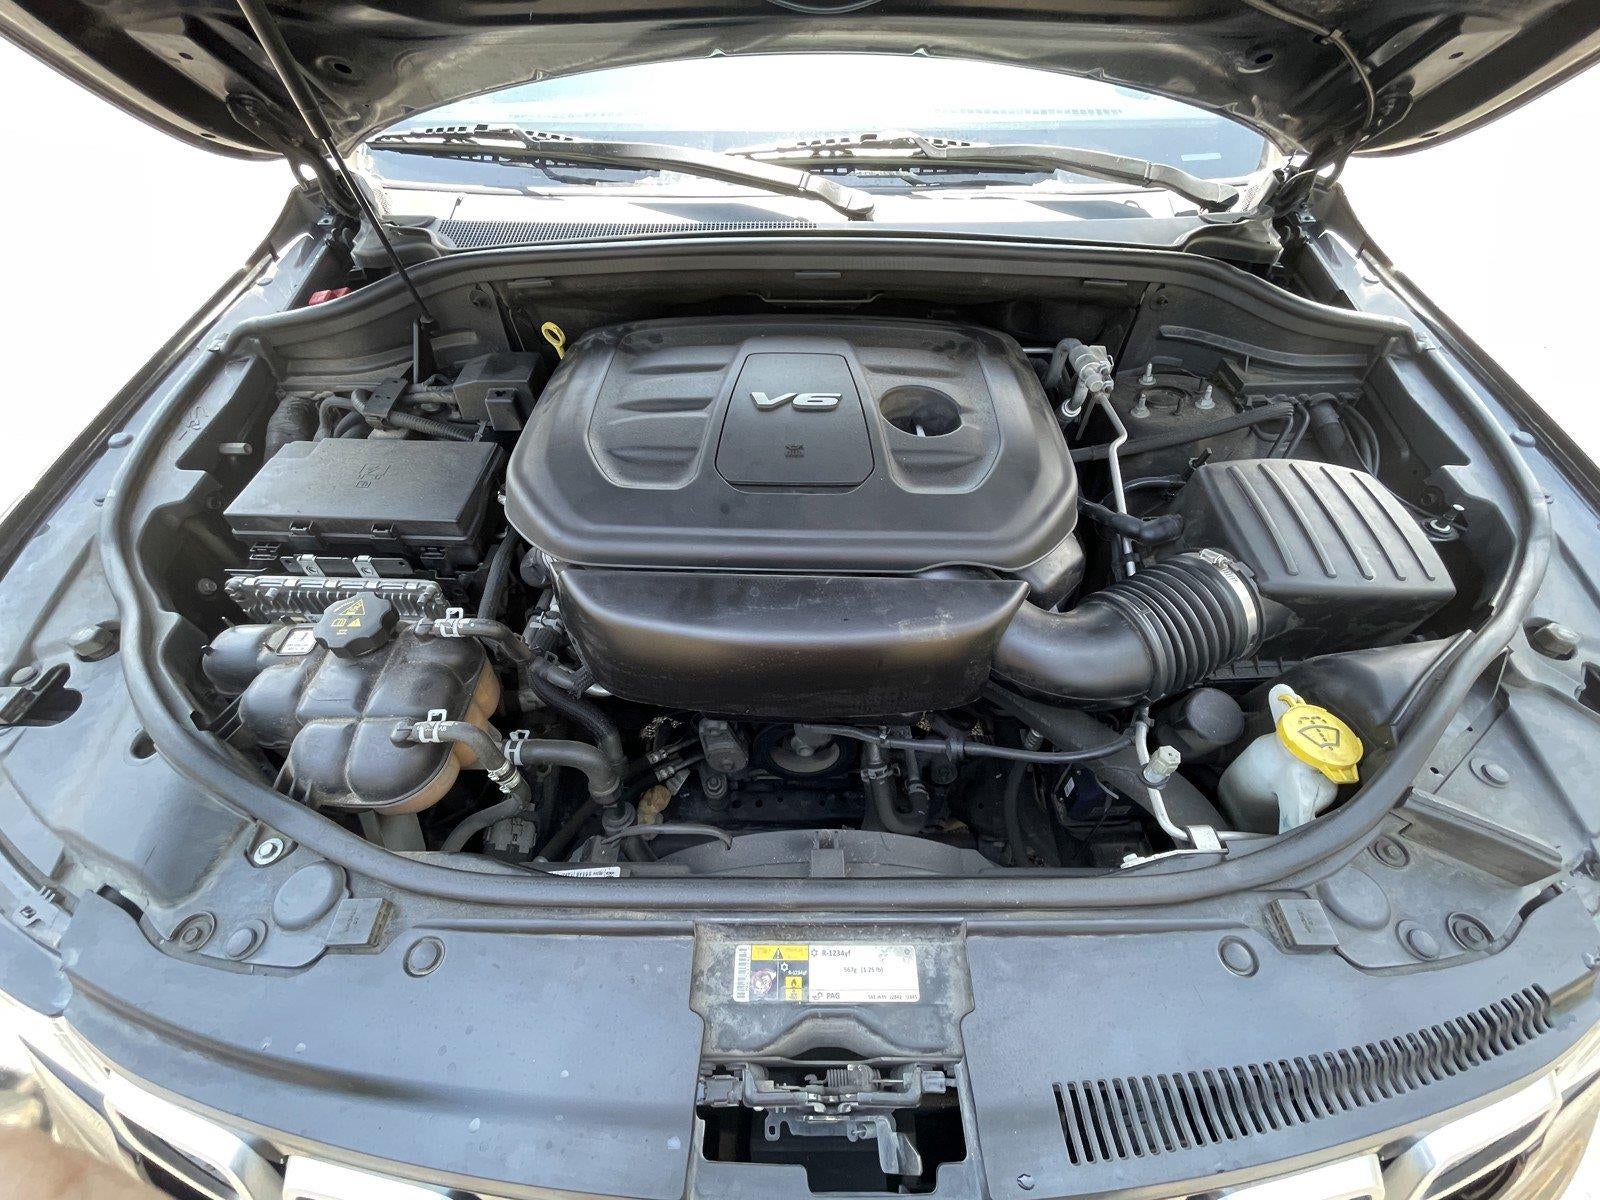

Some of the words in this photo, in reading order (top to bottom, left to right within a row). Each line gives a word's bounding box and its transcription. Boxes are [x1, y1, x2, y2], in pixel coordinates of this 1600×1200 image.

[750, 391, 842, 412] V6
[821, 949, 851, 958] R-1234yf
[826, 992, 841, 1000] PAG
